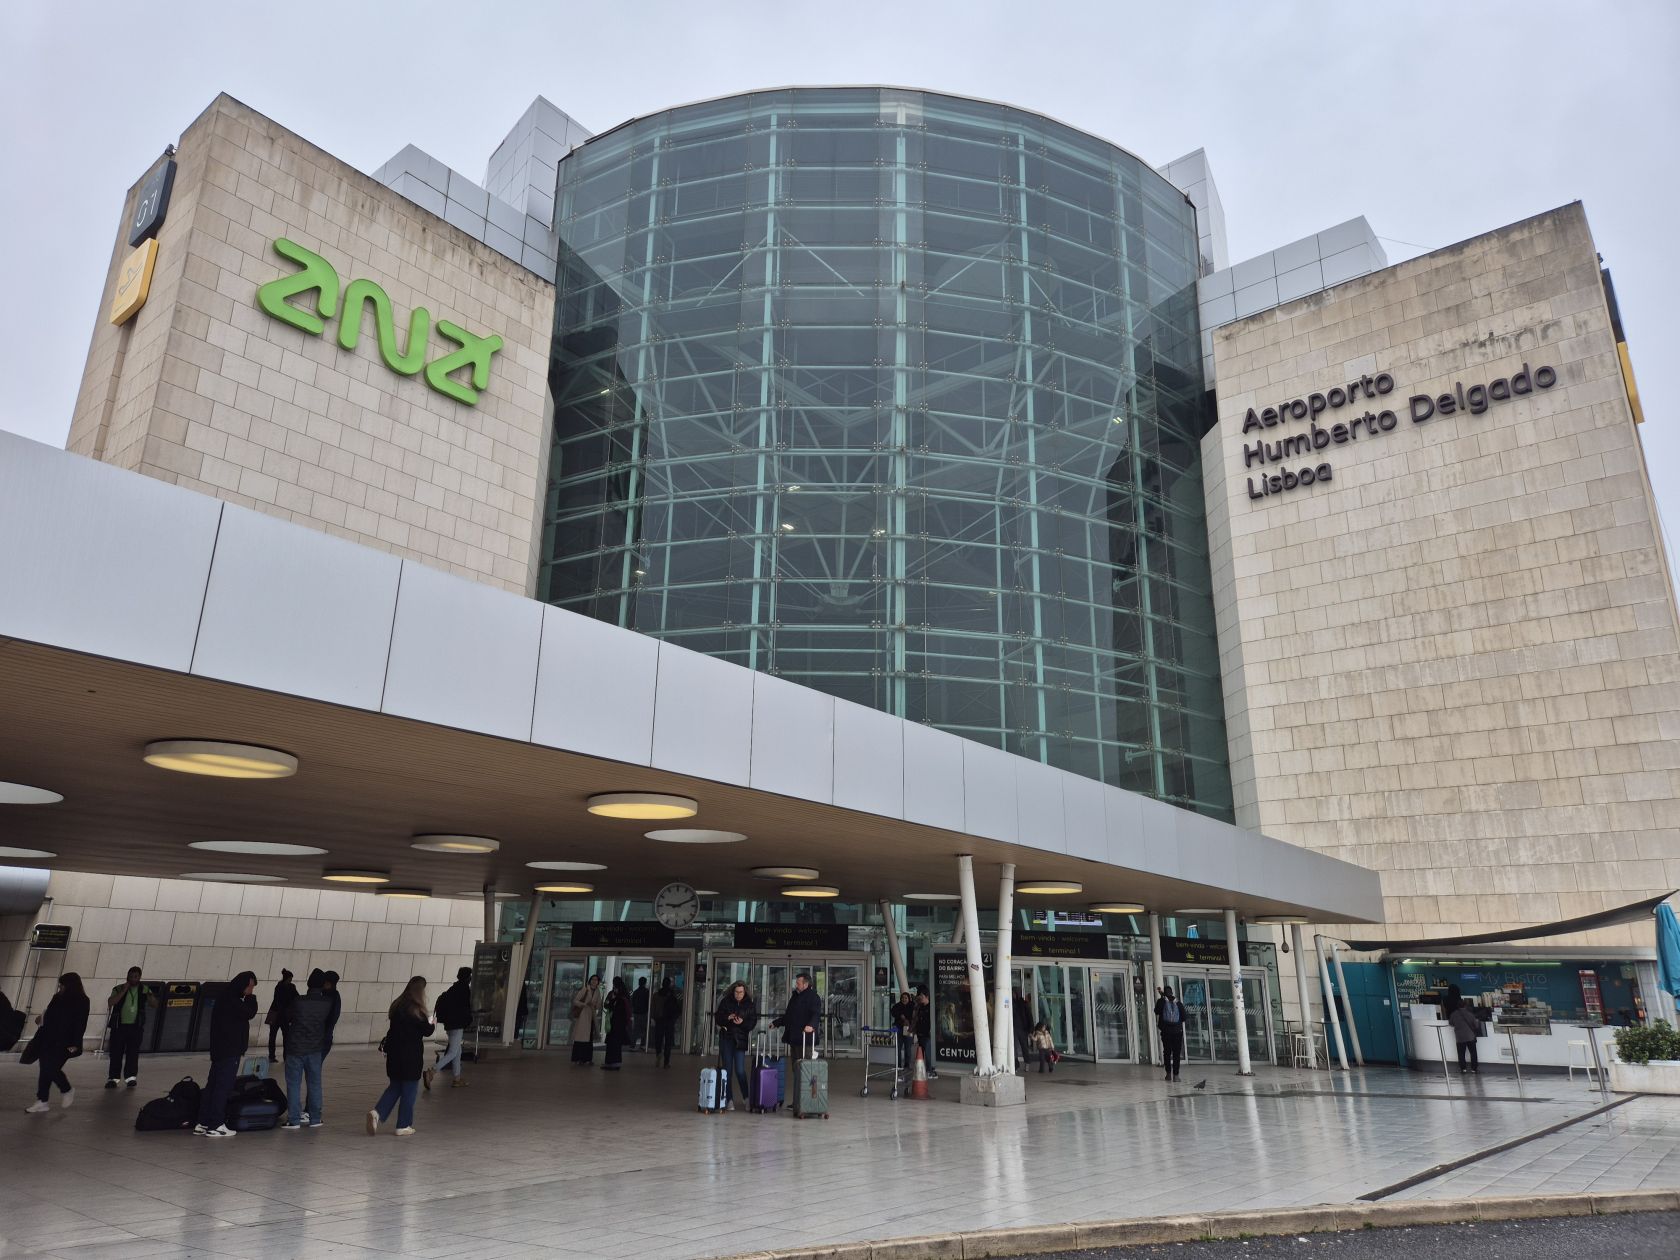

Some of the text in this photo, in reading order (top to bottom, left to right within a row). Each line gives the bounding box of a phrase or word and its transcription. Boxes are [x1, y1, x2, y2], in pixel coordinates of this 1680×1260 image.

[1242, 372, 1395, 434] Aeroporto
[1243, 362, 1557, 468] Humberto Delgado
[1247, 460, 1333, 500] Lisboa
[984, 953, 992, 963] 21
[1479, 971, 1499, 985] My
[1504, 971, 1548, 984] Bistro
[939, 1047, 976, 1059] CENTUR
